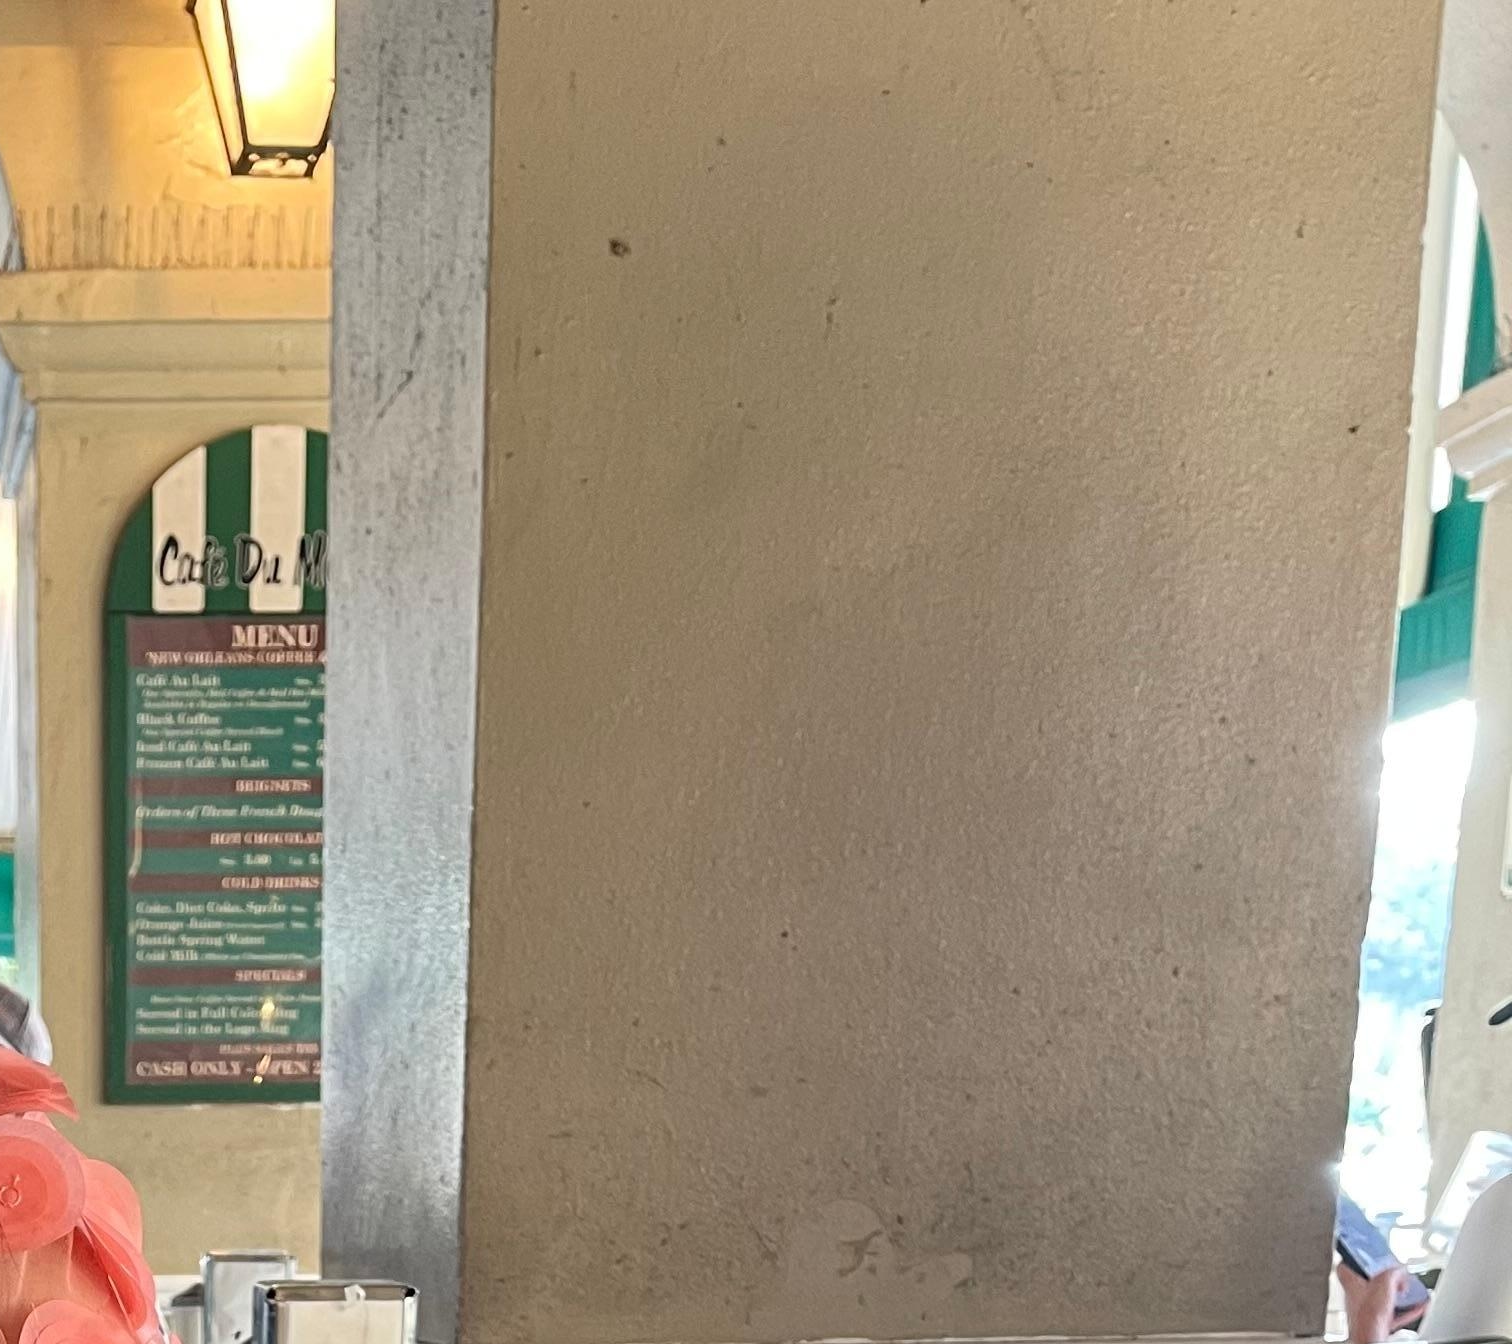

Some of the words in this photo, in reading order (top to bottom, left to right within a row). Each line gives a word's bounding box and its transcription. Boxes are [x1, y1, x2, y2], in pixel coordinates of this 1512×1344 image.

[157, 534, 228, 589] Café
[234, 533, 281, 589] Du
[231, 624, 319, 648] MENU
[235, 780, 311, 792] BEIGNETS
[210, 832, 241, 845] HOT
[221, 877, 263, 888] COLD
[136, 1061, 188, 1076] CASH
[190, 1061, 242, 1076] ONLY
